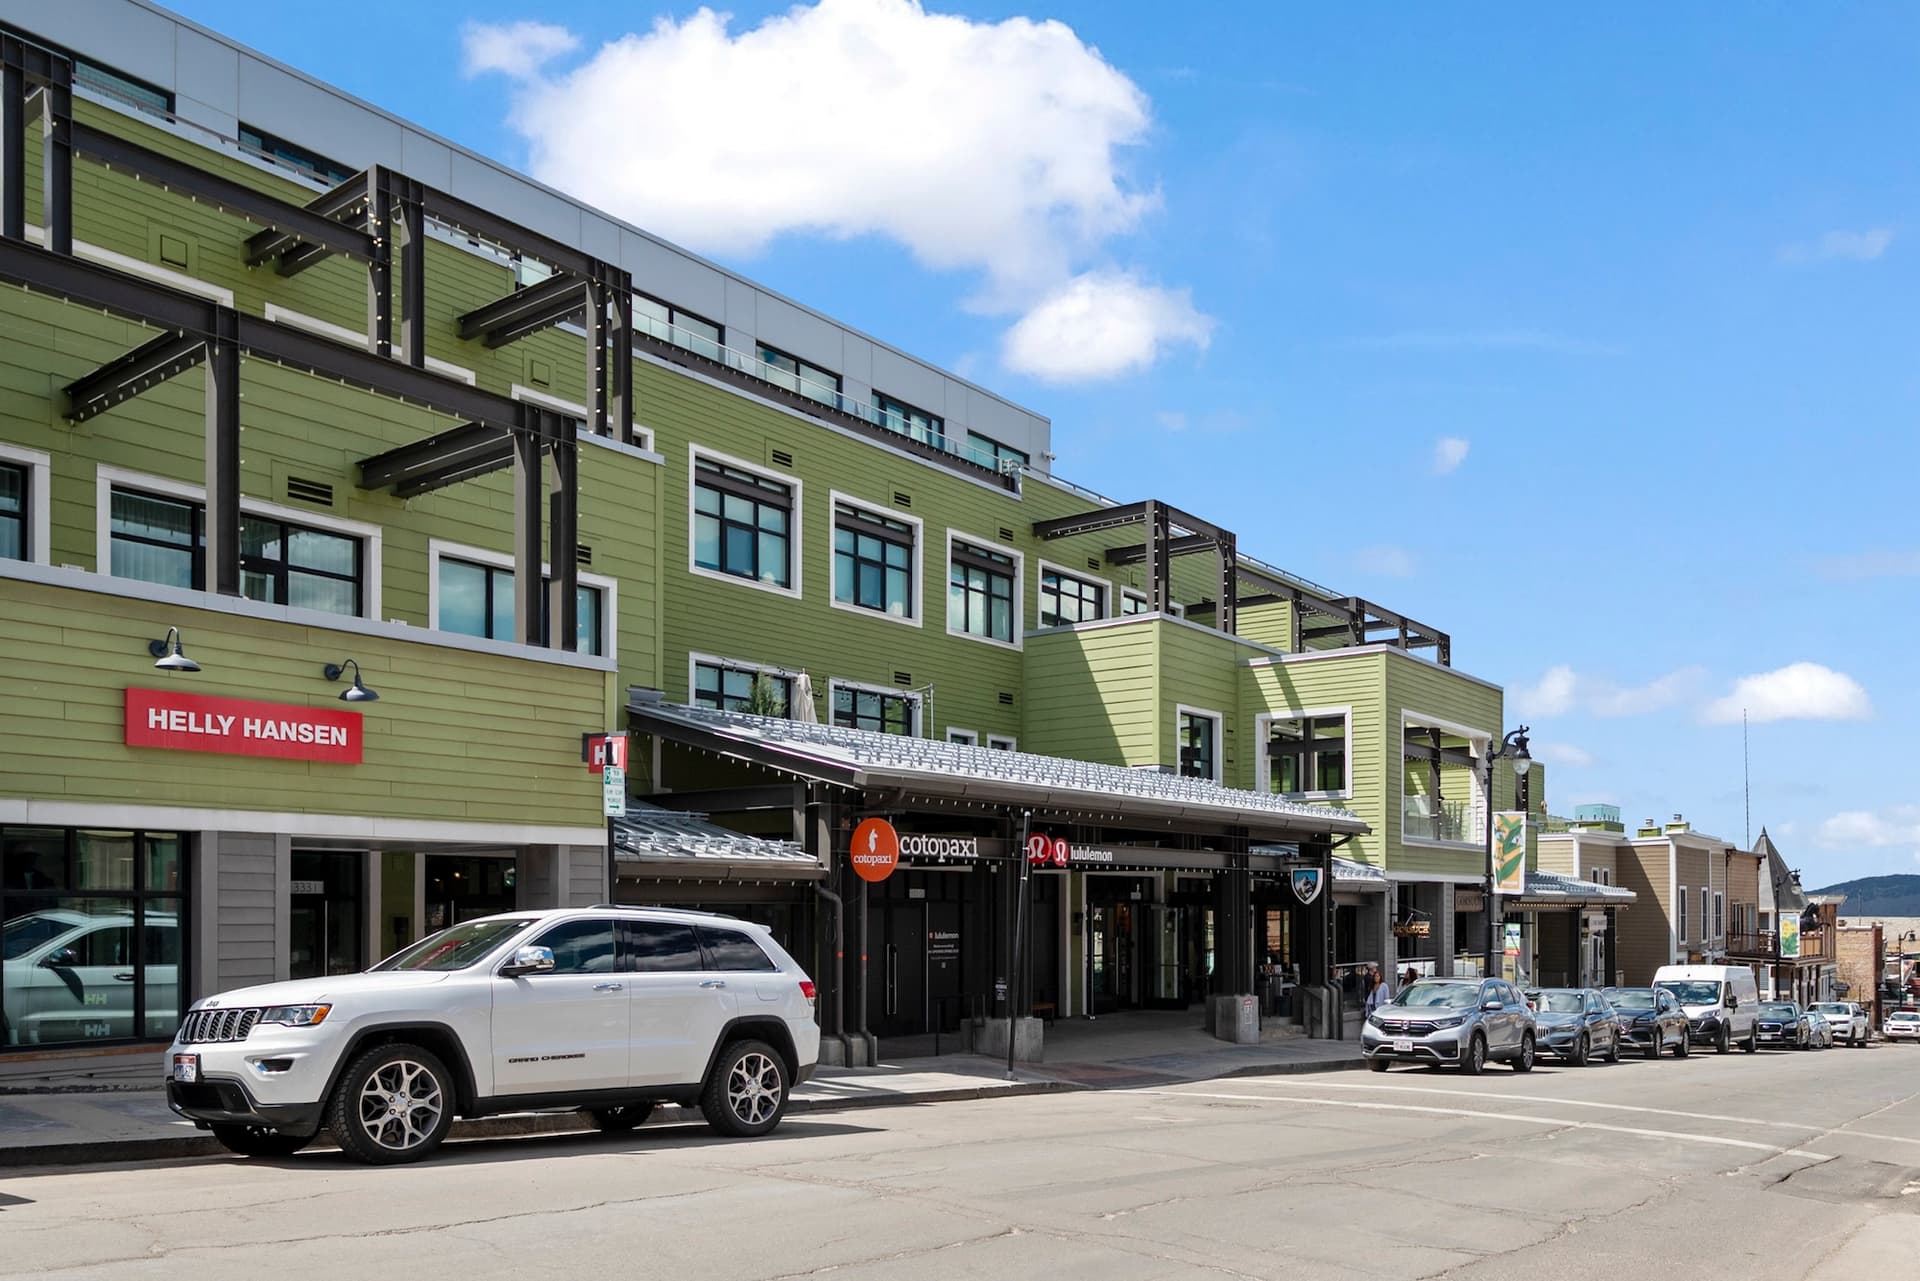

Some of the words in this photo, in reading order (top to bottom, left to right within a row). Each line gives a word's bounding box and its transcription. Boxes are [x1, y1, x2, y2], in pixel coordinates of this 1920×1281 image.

[148, 707, 236, 736] HELLY
[243, 717, 347, 747] HANSEN
[900, 834, 979, 863] cotopaxi
[1070, 845, 1113, 862] lululemon
[853, 853, 892, 866] cotopaxi
[84, 992, 108, 1005] HH
[85, 1023, 110, 1037] HH
